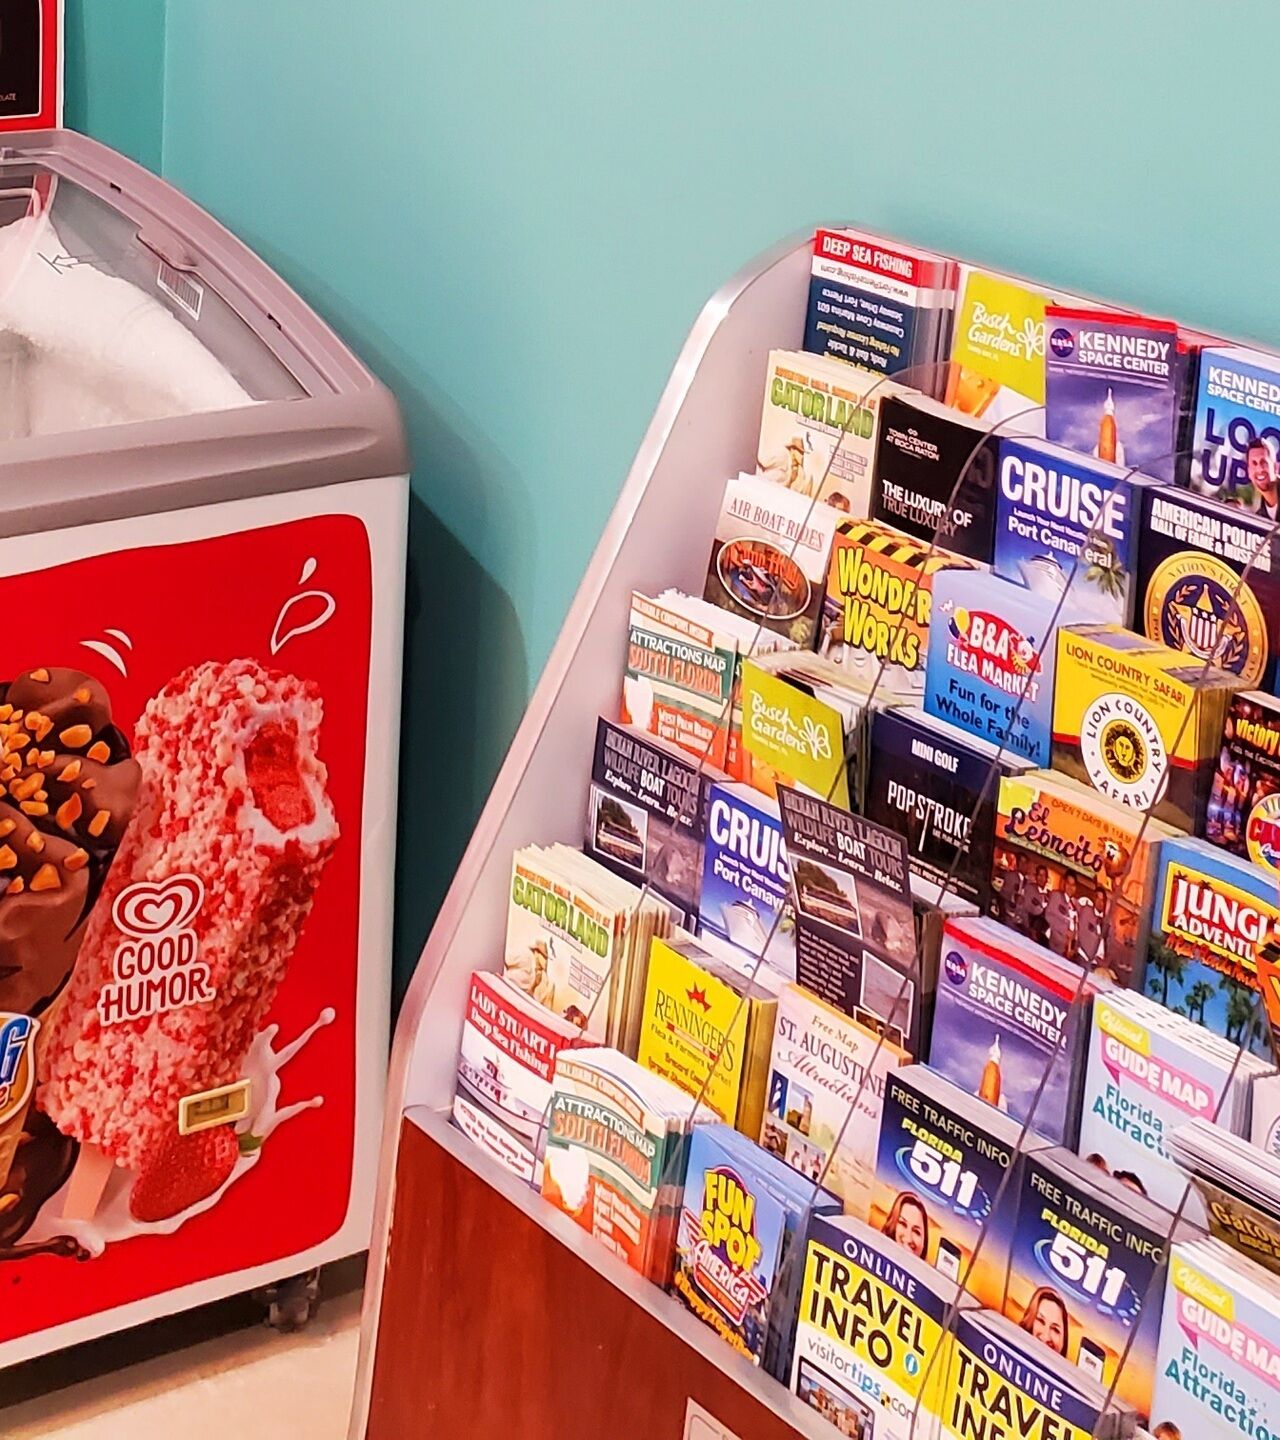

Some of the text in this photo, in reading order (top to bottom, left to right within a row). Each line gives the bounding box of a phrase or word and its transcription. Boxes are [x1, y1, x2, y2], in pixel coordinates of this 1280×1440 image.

[822, 236, 913, 279] DEEP SEA FISHING
[967, 326, 1022, 359] Gardens
[973, 301, 1017, 336] Busch
[1050, 335, 1074, 350] NASA
[1079, 330, 1170, 360] KENNEDY
[1079, 350, 1169, 376] SPACE CENTER
[1207, 383, 1245, 407] SPACE
[888, 428, 937, 452] TOWN CENTER
[895, 438, 914, 451] BOCA
[915, 446, 939, 461] RATON
[882, 480, 973, 528] THE LUXURY OF
[882, 494, 958, 538] TRUE LUXURY
[1001, 455, 1126, 540] CRUISE
[730, 497, 825, 552] AIR BOAT RIDES
[1009, 516, 1038, 541] Port
[1040, 528, 1112, 568] Canaveral
[1150, 516, 1175, 538] HALL
[1151, 498, 1221, 544] AMERICAN
[1221, 521, 1272, 556] POLICE
[837, 545, 932, 627] WONDER
[630, 630, 726, 673] ATTRACTIONS MAP
[841, 595, 919, 670] WORKS
[969, 613, 1011, 661] B&A
[946, 643, 980, 678] FLEA
[982, 660, 1039, 706] MARKET
[1066, 643, 1093, 663] LION
[1097, 656, 1151, 686] COUNTRY
[1154, 679, 1186, 706] SAFARI
[935, 694, 1041, 759] Whole Family!
[949, 679, 1029, 730] Fun for the
[911, 738, 960, 774] MINI GOLF
[1236, 719, 1279, 755] Victory
[1004, 807, 1104, 872] Leoncito
[119, 934, 196, 982] GOOD
[100, 964, 211, 1023] HUMOR
[470, 986, 556, 1061] LADY STUART I
[491, 1027, 509, 1049] Sea
[651, 1023, 666, 1041] Flea
[811, 1014, 859, 1053] Free Map
[778, 1015, 886, 1099] ST. AUGUSTINE
[889, 1083, 1011, 1169] FREE TRAFFIC INFO
[703, 1167, 756, 1231] FUN
[910, 1138, 981, 1211] 511
[700, 1210, 762, 1276] SPOT
[842, 1237, 918, 1300] ONLINE
[1048, 1230, 1128, 1308] 511
[809, 1248, 926, 1357] TRAVEL
[984, 1343, 1062, 1410] ONLINE
